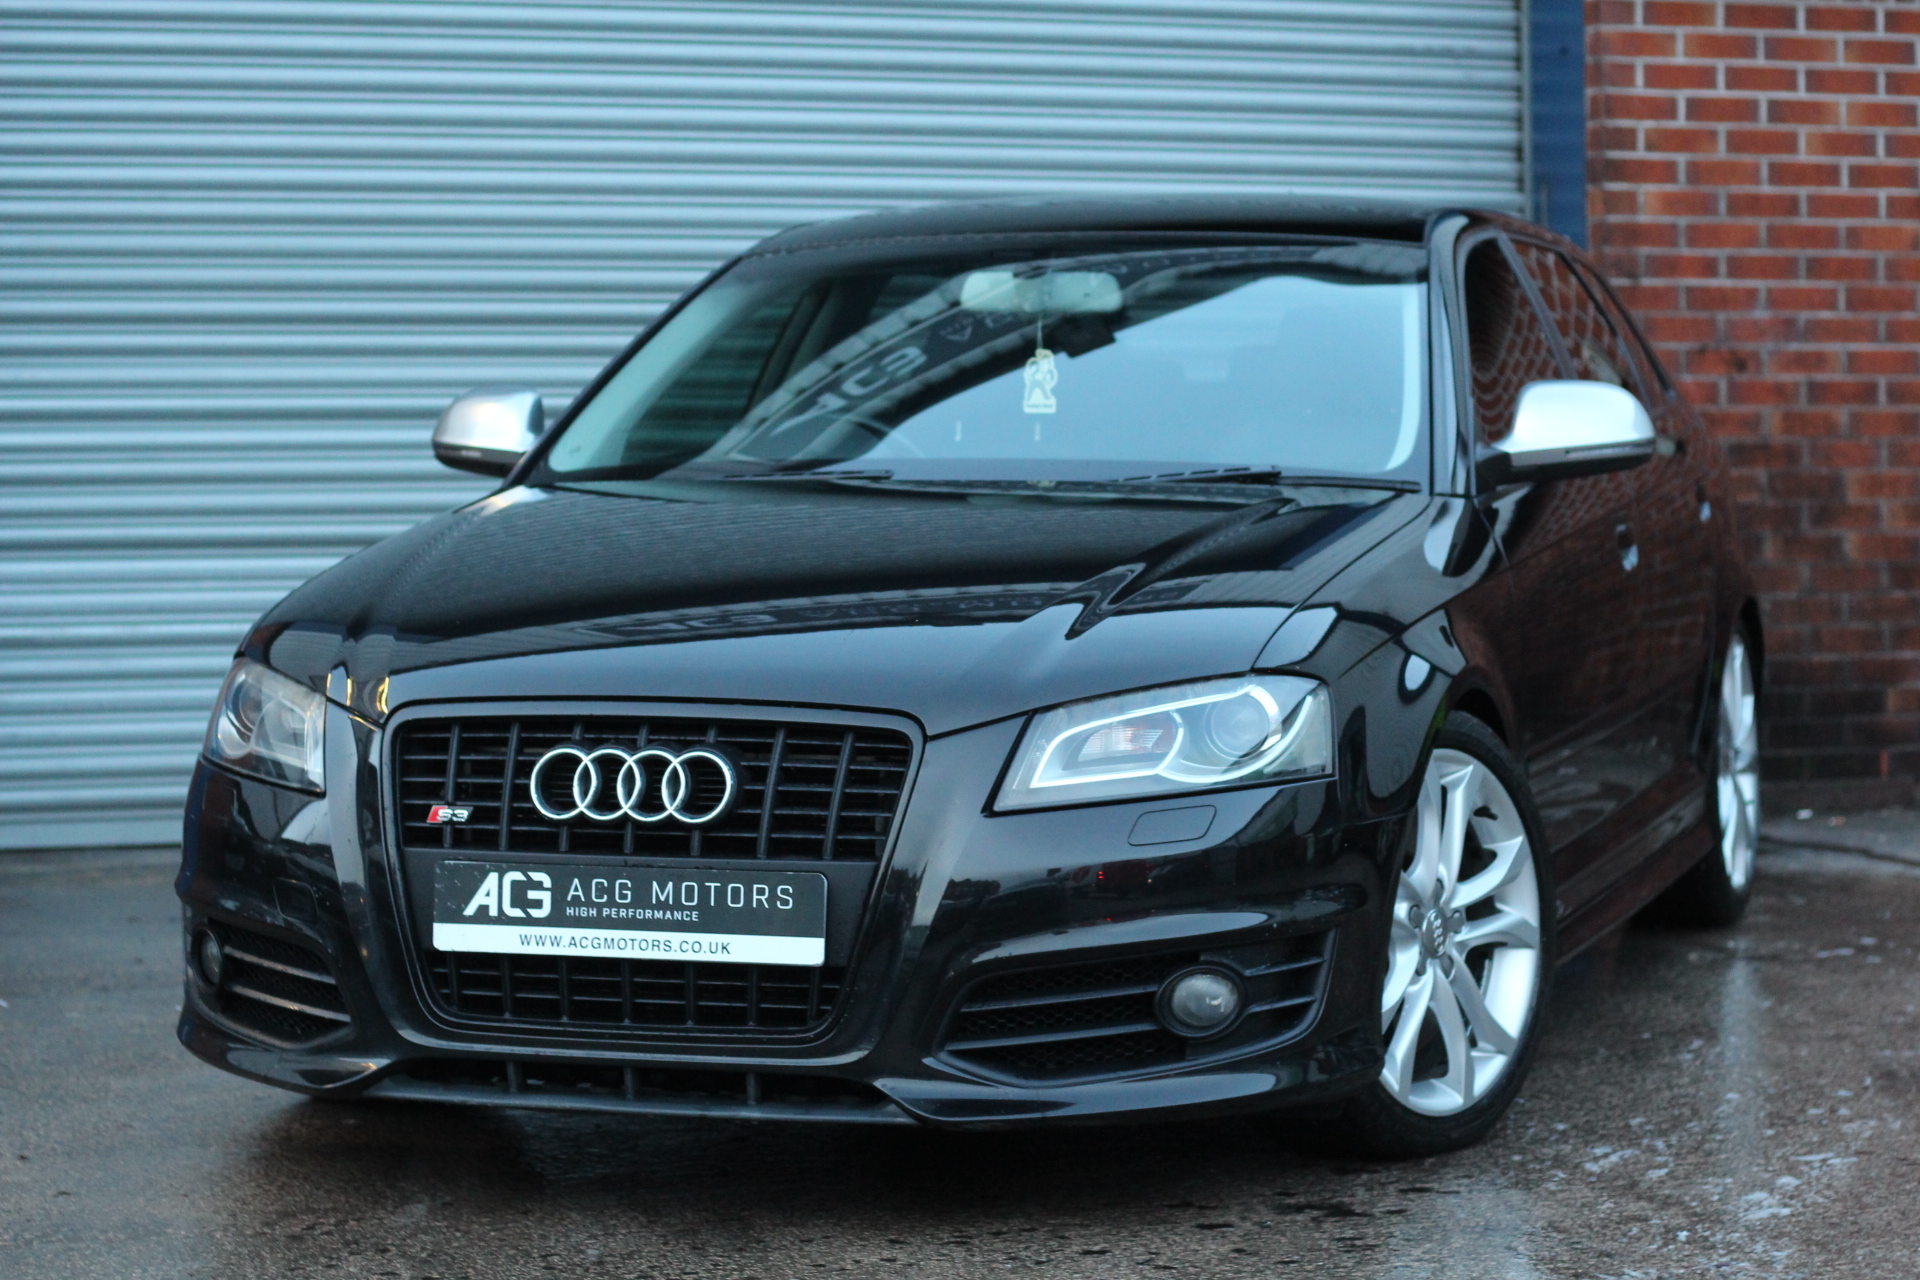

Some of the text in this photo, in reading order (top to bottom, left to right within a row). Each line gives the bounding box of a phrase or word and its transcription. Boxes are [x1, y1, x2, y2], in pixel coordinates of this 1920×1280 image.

[436, 808, 469, 822] S3
[463, 870, 552, 919] ACG
[566, 878, 794, 910] ACG MOTORS
[566, 906, 700, 922] HIGH PERFORMANCE
[519, 933, 731, 956] WWW.ACGMOTORS.CO.UK
